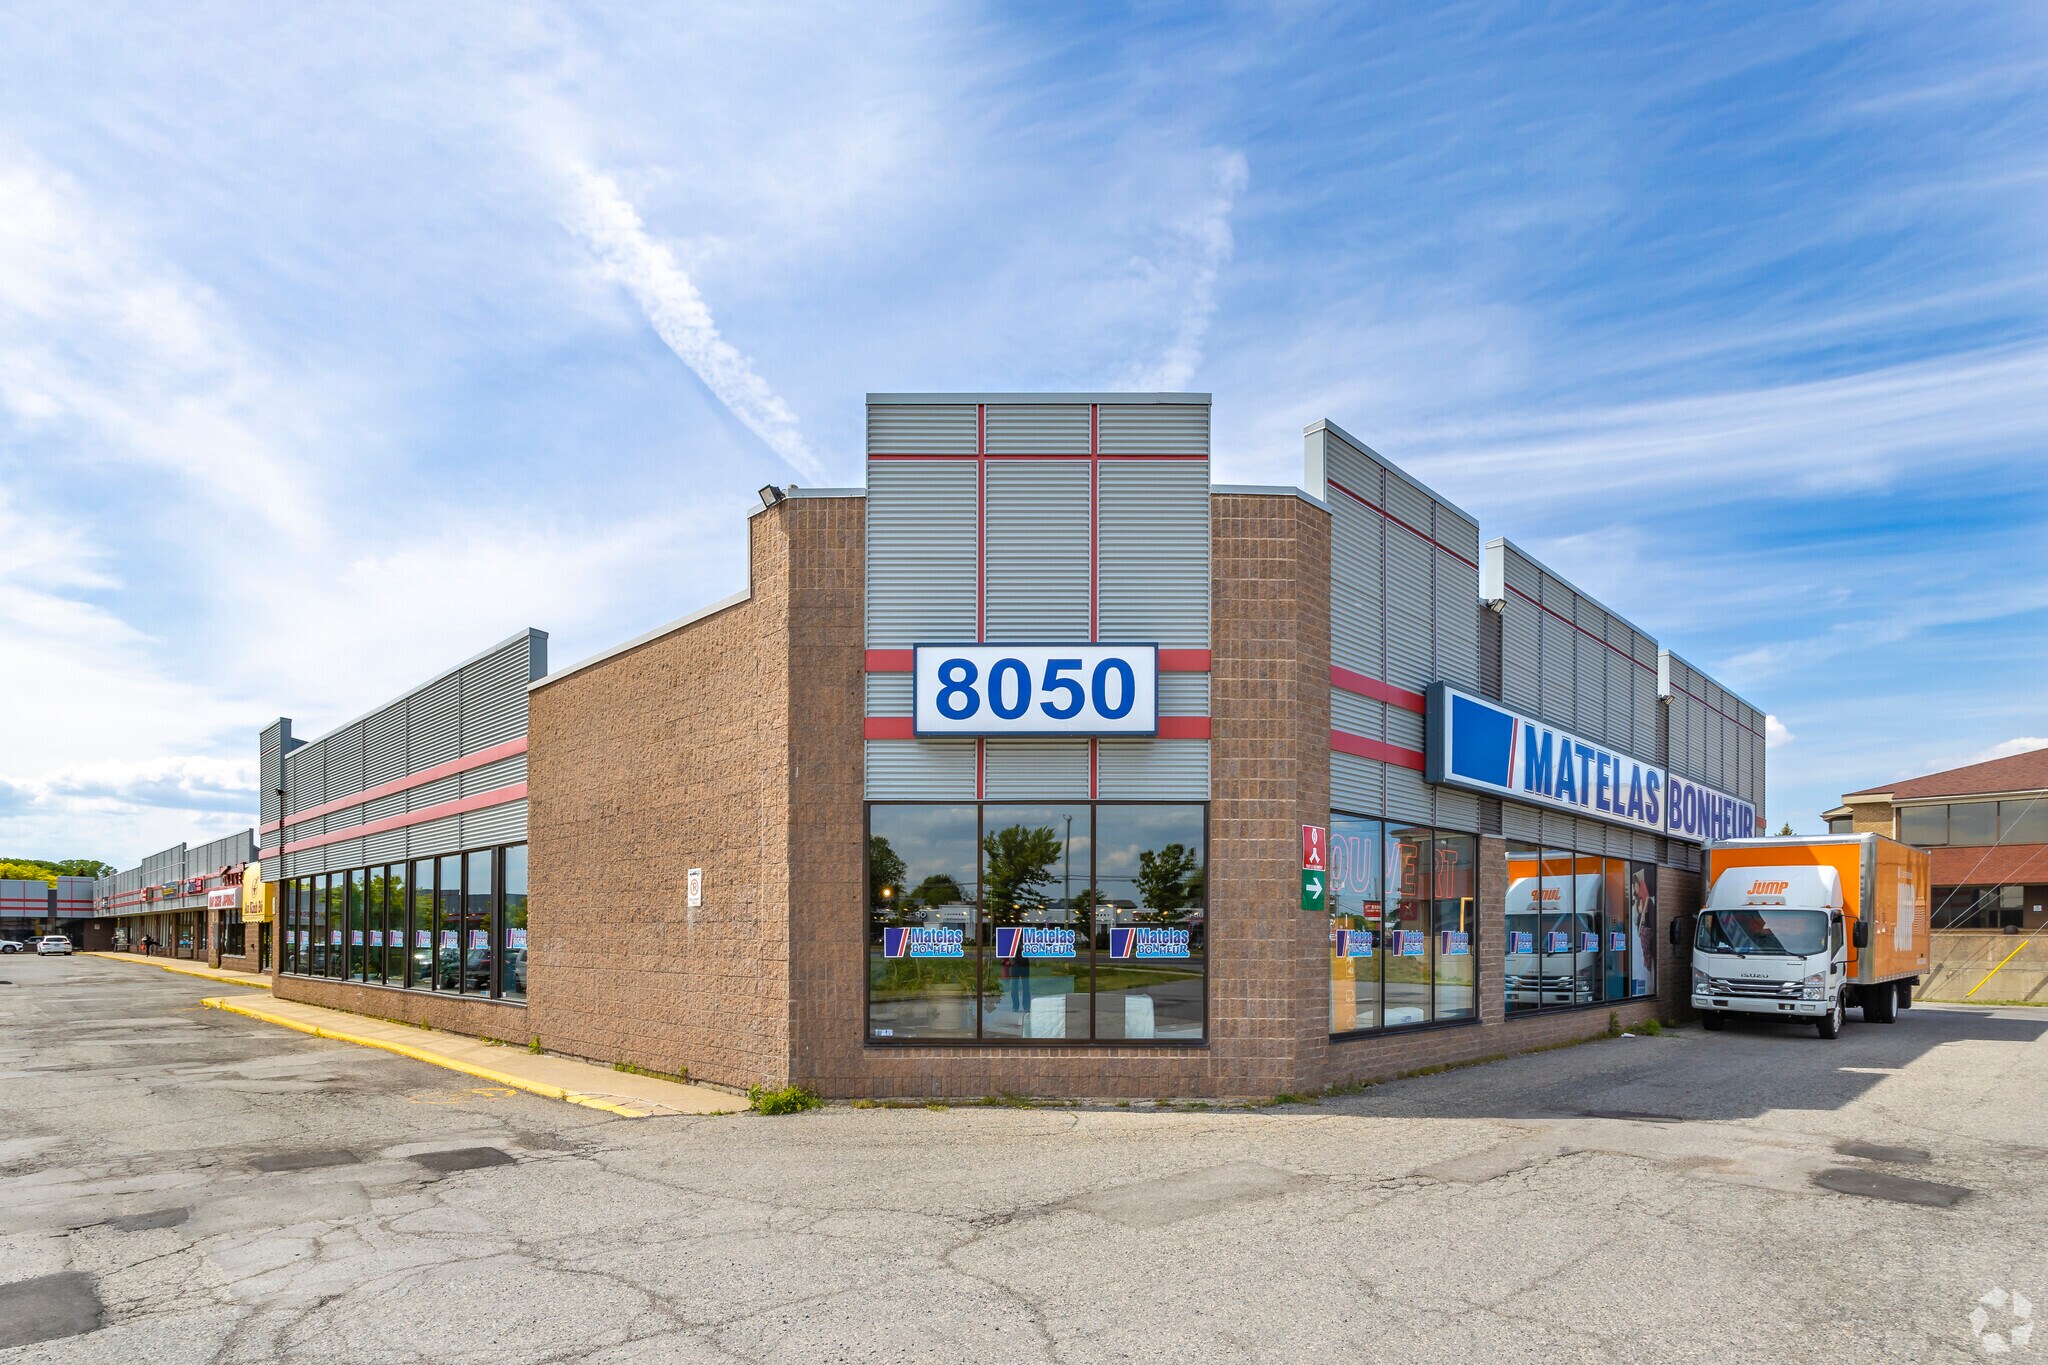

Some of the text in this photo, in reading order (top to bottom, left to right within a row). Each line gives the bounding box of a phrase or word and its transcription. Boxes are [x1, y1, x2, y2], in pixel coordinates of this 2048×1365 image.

[935, 657, 1136, 721] 8050
[1523, 721, 1755, 839] MATELAS BONHEUR
[911, 927, 962, 943] Matelas
[1023, 927, 1074, 943] Matelas
[1137, 927, 1188, 943] Matelas
[912, 943, 961, 954] BONHEUR
[1024, 943, 1073, 954] BONHEUR
[1138, 943, 1187, 954] BONHEUR
